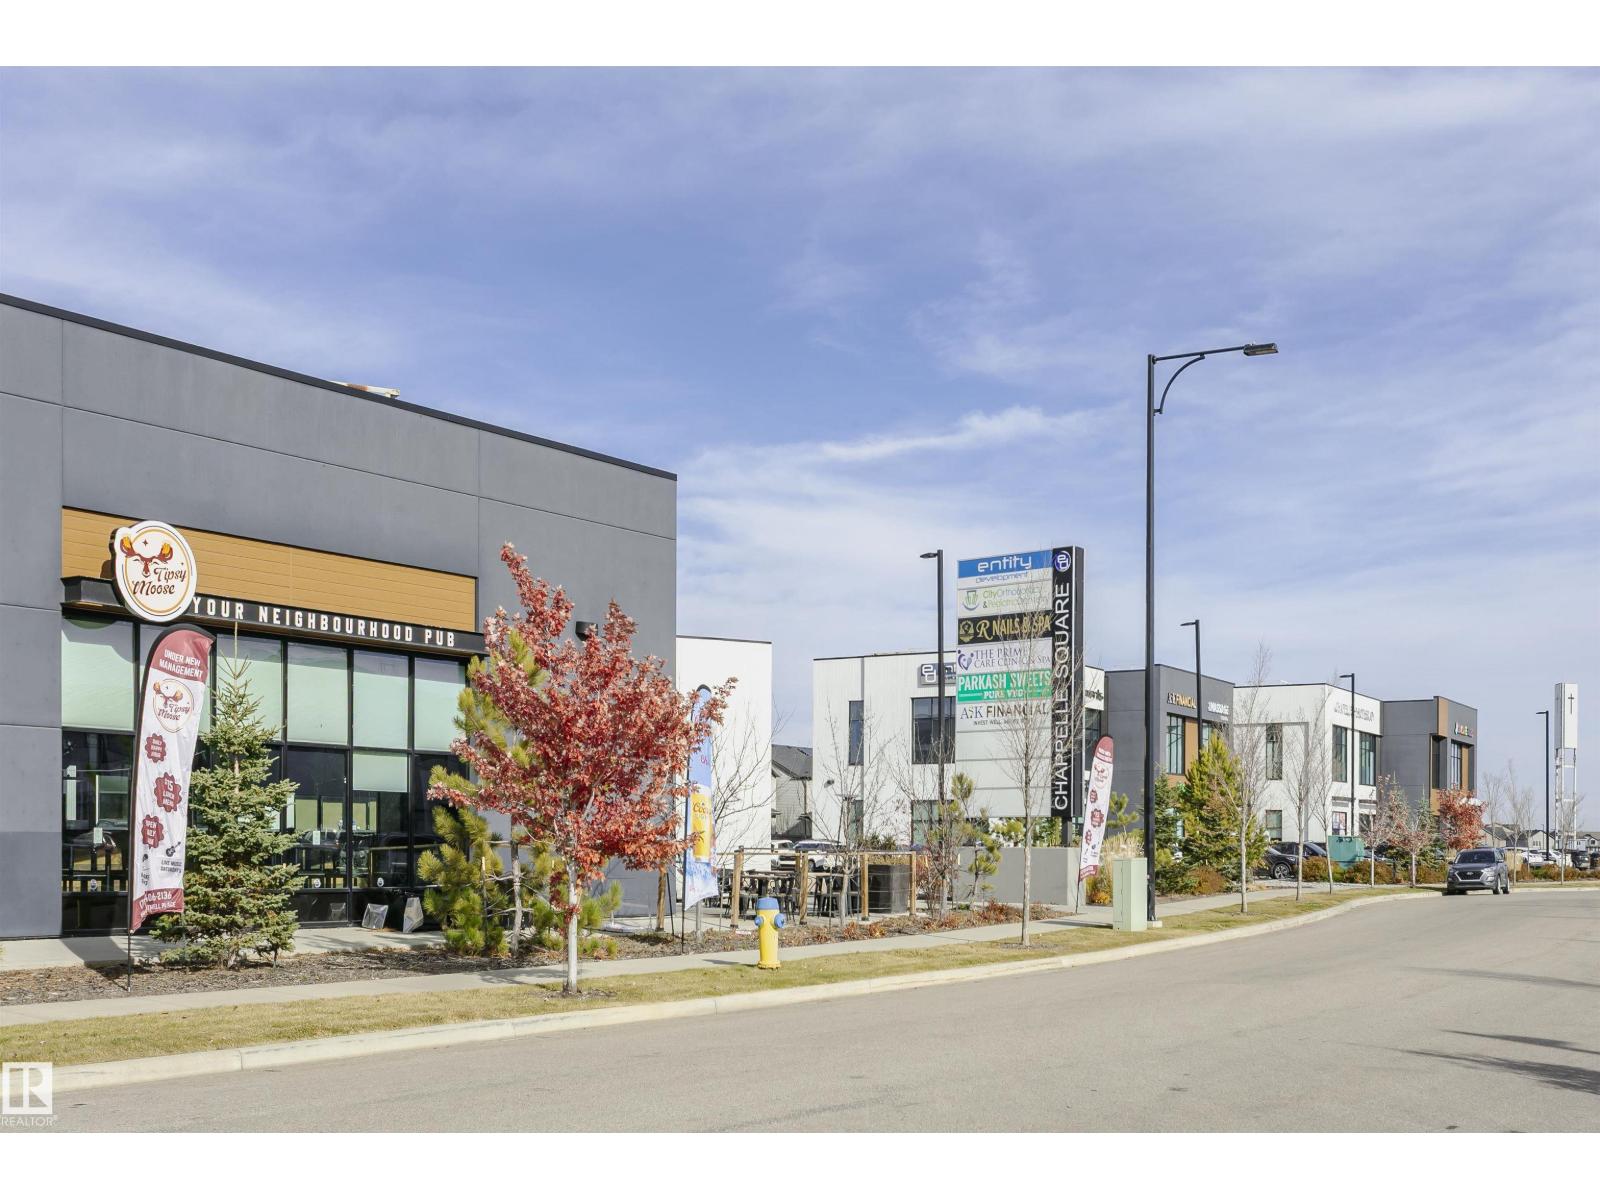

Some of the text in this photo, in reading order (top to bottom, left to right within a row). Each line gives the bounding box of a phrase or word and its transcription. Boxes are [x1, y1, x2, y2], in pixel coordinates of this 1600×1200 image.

[978, 555, 1032, 573] entity
[153, 567, 187, 584] Tipsy
[975, 572, 1029, 584] development
[132, 580, 176, 596] Moose
[192, 597, 455, 647] YOUR NEIGHBOURHOOD PUB
[992, 616, 1021, 637] NAILS
[1031, 614, 1052, 632] SPA
[164, 649, 201, 667] UNDER NEW
[975, 649, 994, 660] THE
[159, 658, 204, 678] MANAGEMENT
[974, 658, 996, 669] CARE
[958, 670, 1051, 692] PARKASH SWEETS
[983, 690, 1006, 700] PURE
[1054, 582, 1070, 810] CHAPPELLE SQUARE
[986, 702, 1049, 718] FINANCIAL
